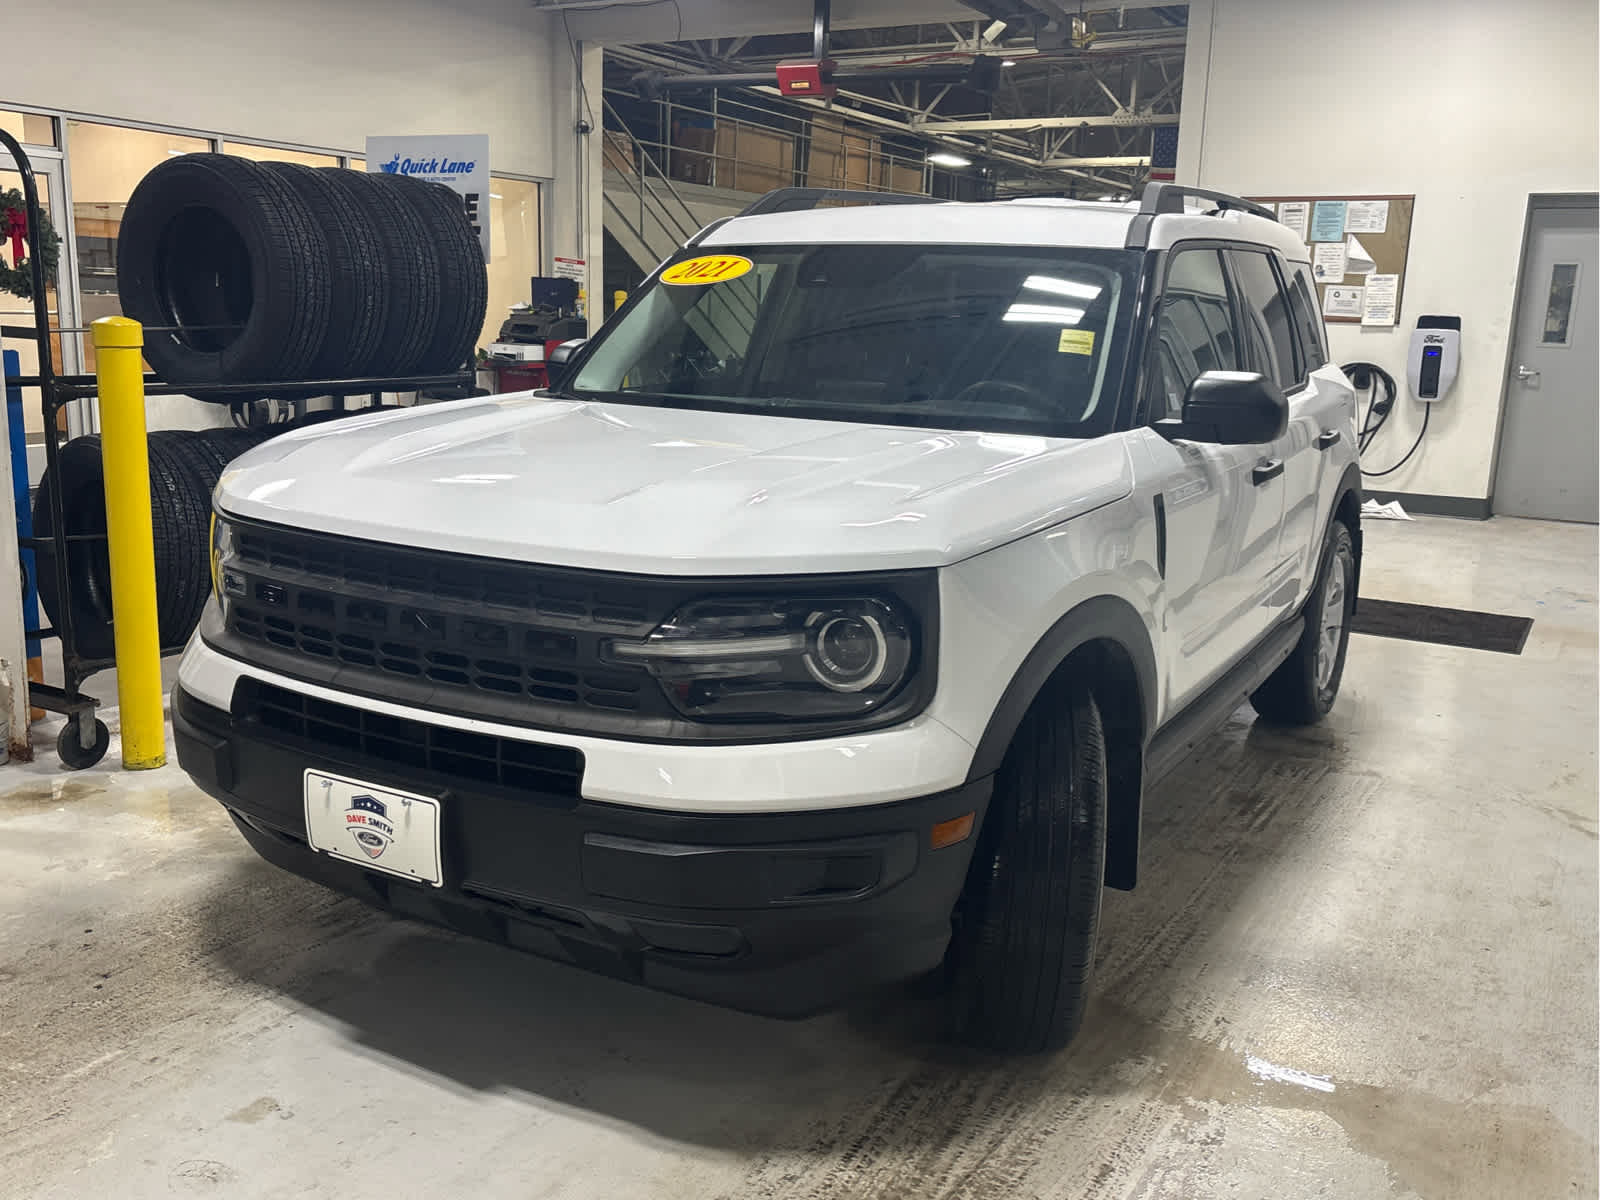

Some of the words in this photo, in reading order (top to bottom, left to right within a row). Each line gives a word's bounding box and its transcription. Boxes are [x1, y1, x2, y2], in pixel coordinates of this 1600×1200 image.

[400, 158, 439, 175] Quick
[440, 158, 475, 174] Lane
[670, 260, 741, 279] 2021
[1423, 334, 1446, 344] Ford
[346, 814, 367, 824] DAVE
[368, 817, 393, 835] SMITH
